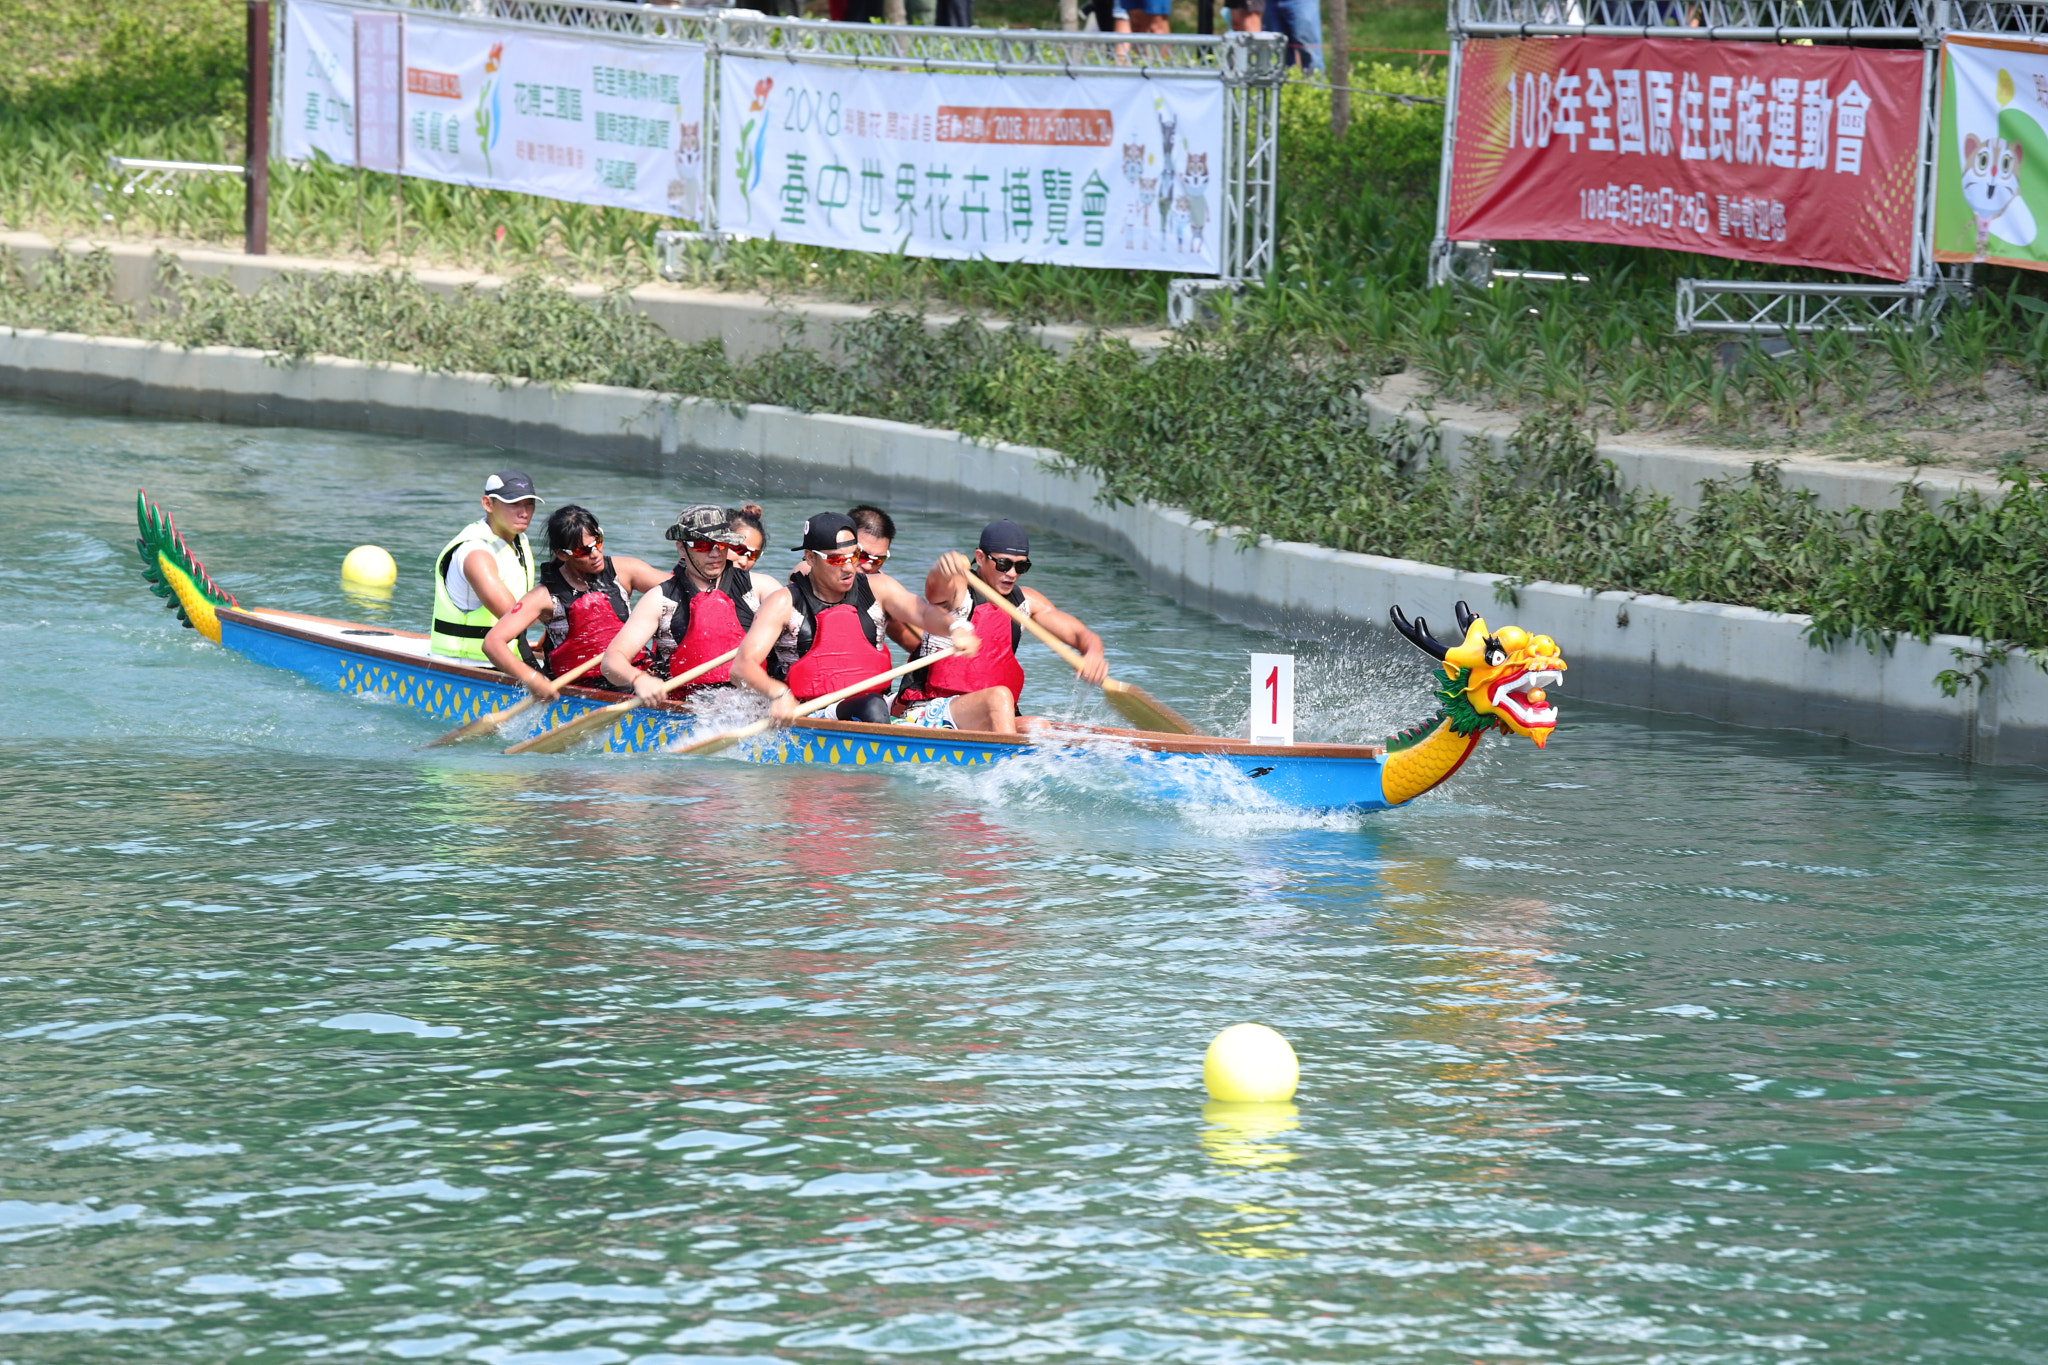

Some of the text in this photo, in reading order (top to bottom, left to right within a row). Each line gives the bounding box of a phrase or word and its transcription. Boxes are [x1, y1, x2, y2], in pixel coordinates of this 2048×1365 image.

[514, 82, 583, 121] 花博三園區
[784, 87, 841, 136] 2018
[1507, 66, 1872, 176] 108年全國原住民族運動會
[779, 150, 1109, 247] 臺中世界花卉博覽會
[1266, 666, 1278, 724] 1
